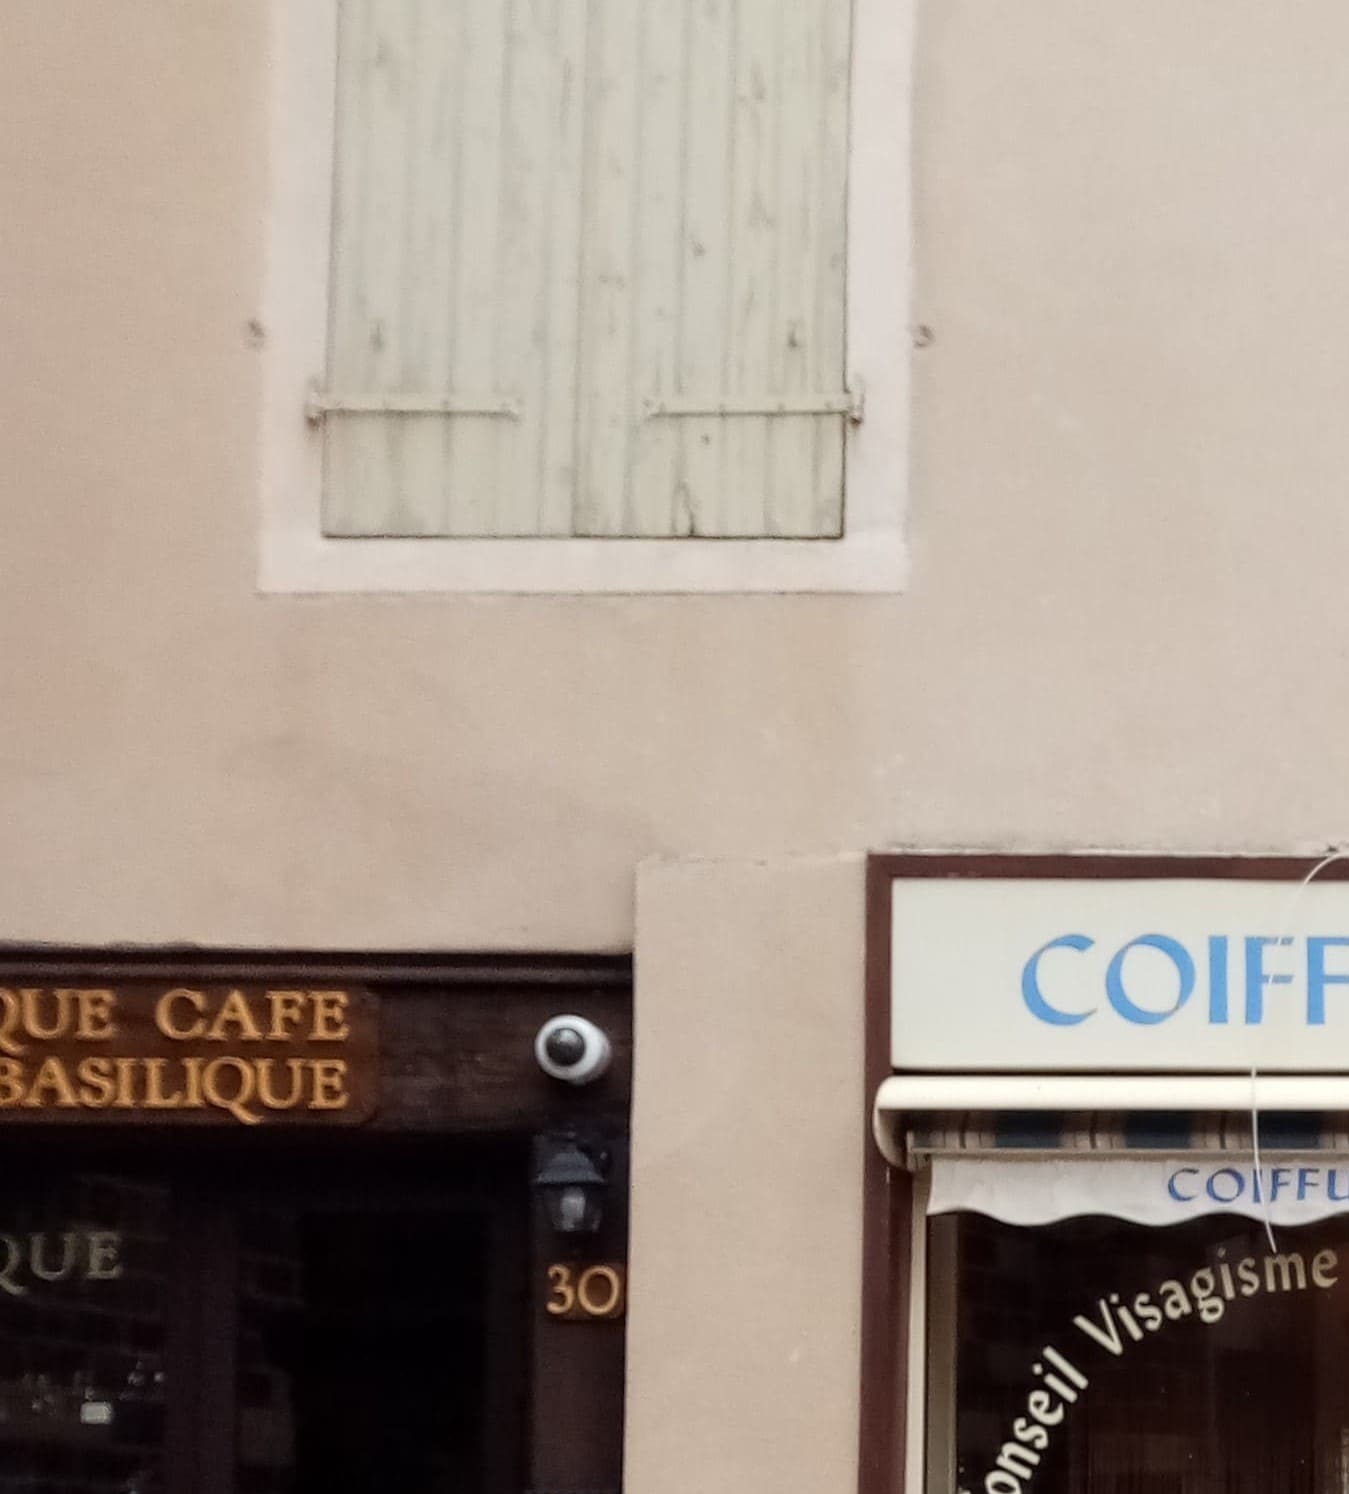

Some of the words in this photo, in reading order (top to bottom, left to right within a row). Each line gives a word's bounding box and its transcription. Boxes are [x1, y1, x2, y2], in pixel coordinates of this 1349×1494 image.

[156, 989, 350, 1041] CAFE
[547, 1264, 621, 1315] 30
[1072, 1247, 1339, 1356] Visagisme
